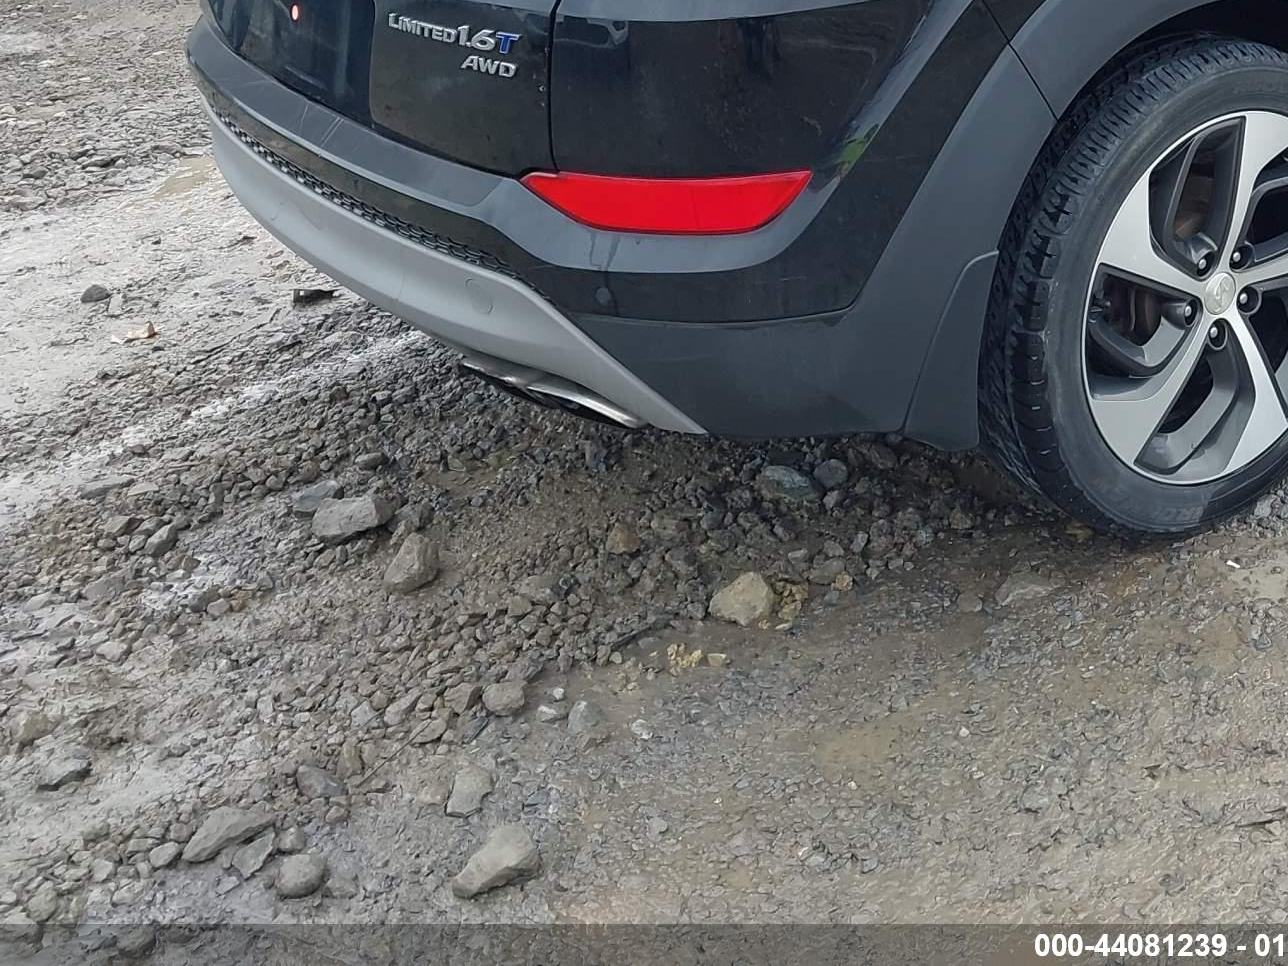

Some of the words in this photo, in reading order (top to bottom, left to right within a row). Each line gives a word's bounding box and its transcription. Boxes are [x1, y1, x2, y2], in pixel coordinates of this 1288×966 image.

[388, 12, 457, 44] LIMITED
[457, 24, 522, 54] 1.6T
[460, 55, 517, 78] AWD
